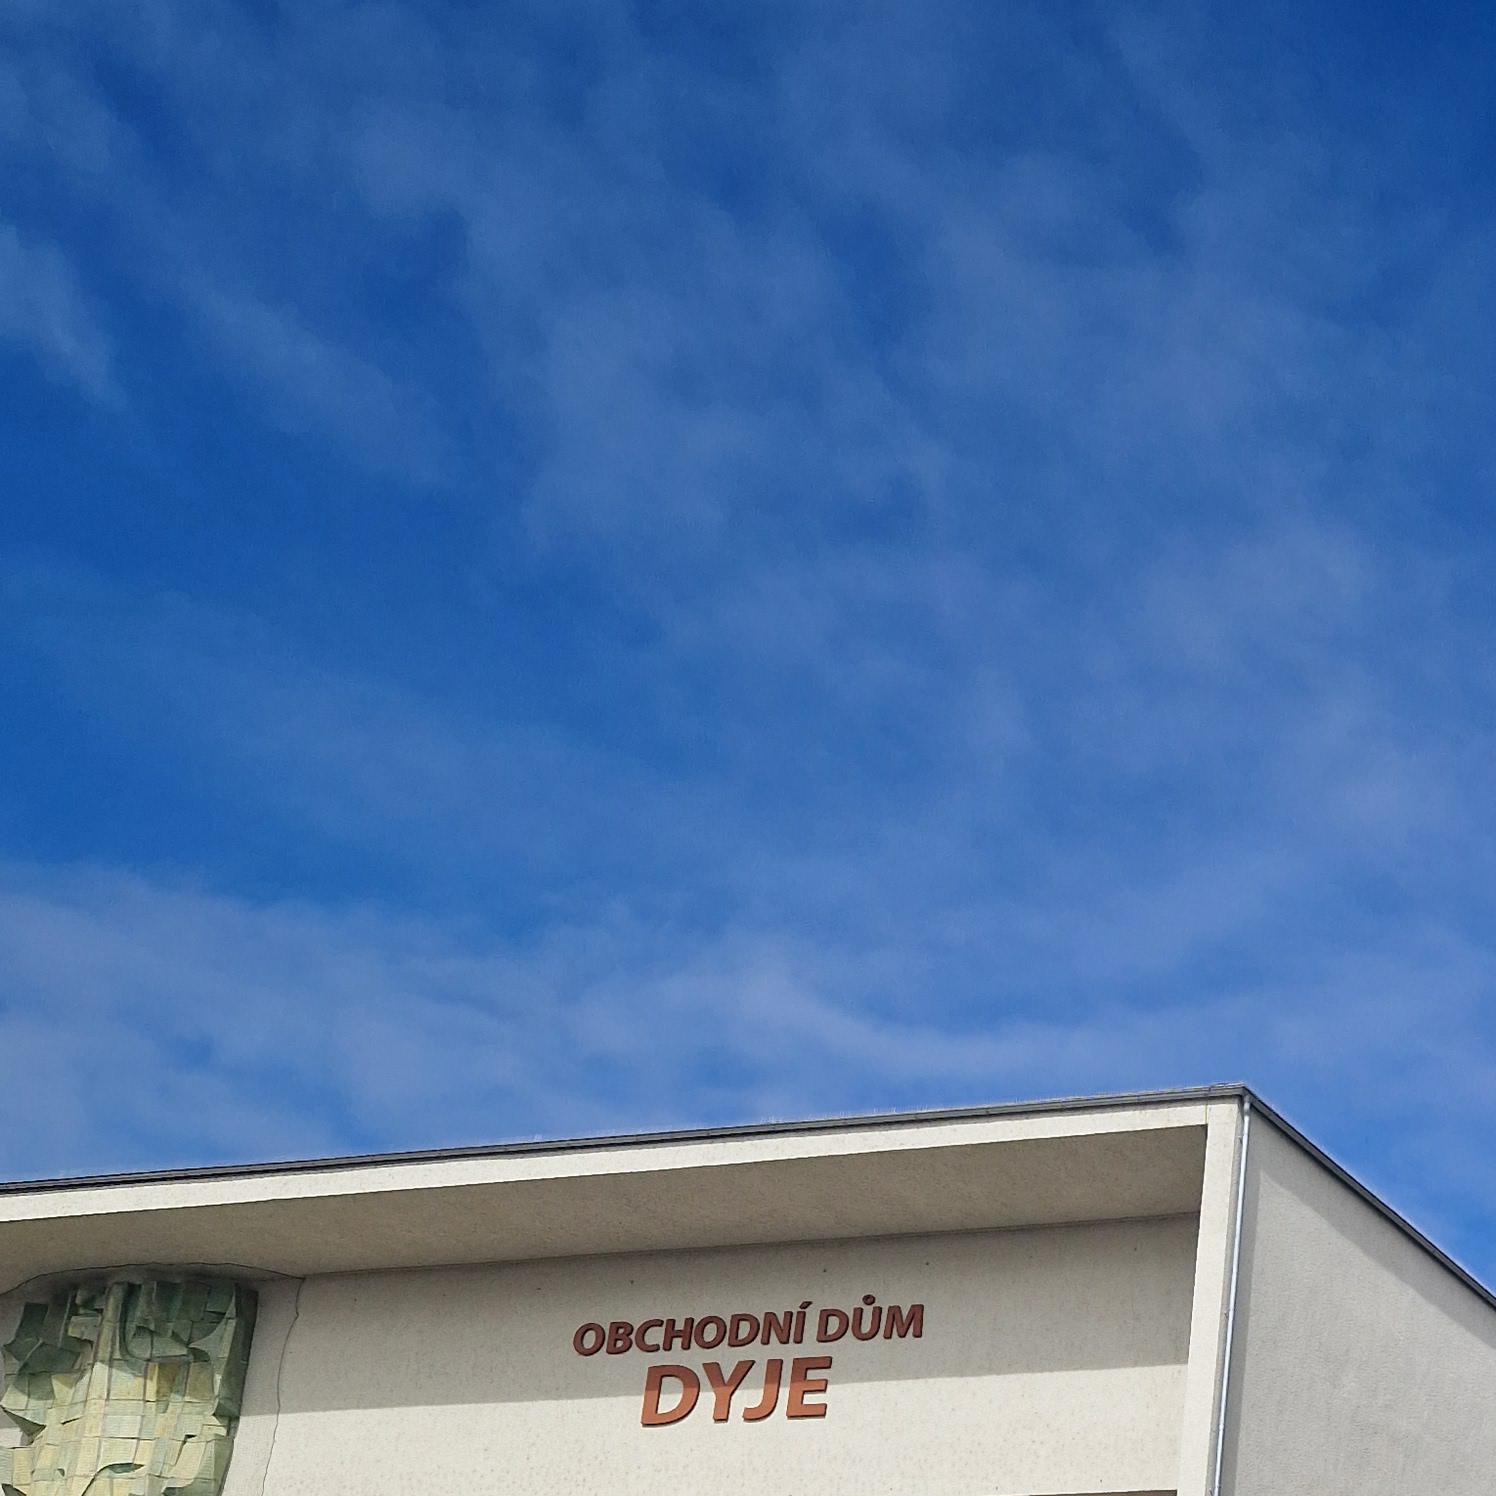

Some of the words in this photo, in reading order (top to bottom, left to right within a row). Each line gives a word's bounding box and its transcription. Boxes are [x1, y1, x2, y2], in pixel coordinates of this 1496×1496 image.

[573, 1301, 813, 1357] OBCHODNÍ
[816, 1294, 925, 1344] DŮM
[641, 1356, 833, 1428] DYJE
